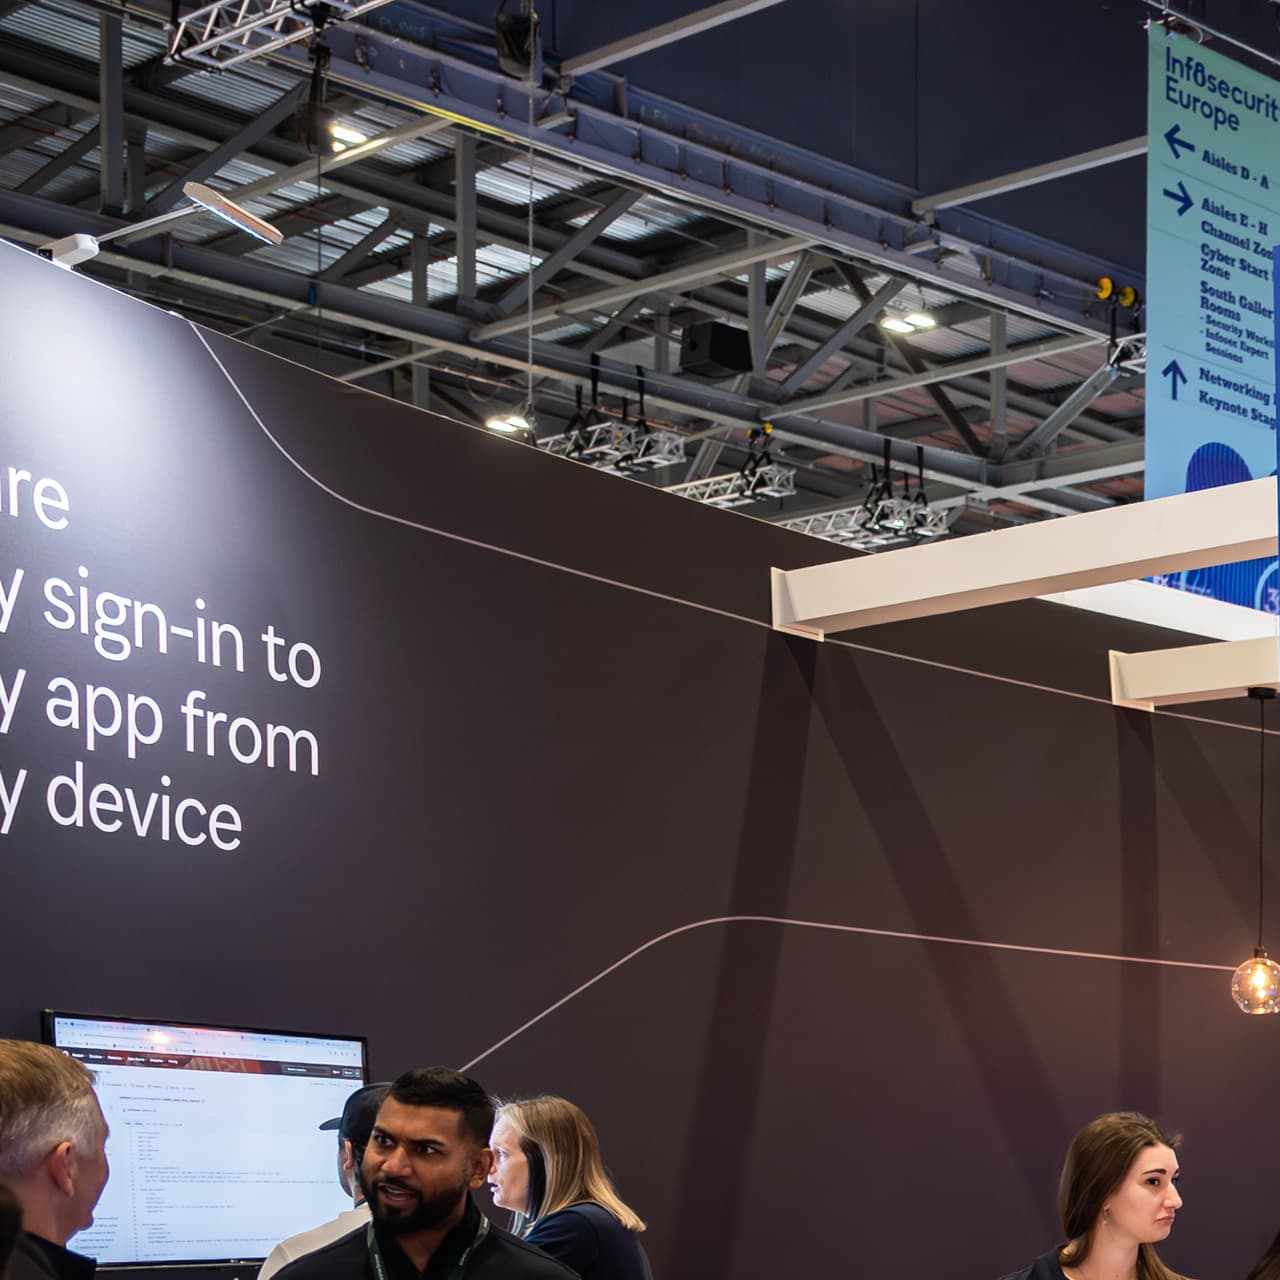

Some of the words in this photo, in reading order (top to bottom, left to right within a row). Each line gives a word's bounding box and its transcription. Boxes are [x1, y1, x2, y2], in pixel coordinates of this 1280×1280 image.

[1166, 75, 1240, 131] Europe
[1202, 150, 1238, 175] Aisles
[1241, 166, 1250, 180] D
[1260, 176, 1270, 189] A
[1201, 198, 1237, 223] Aisles
[1240, 213, 1248, 228] E
[1258, 221, 1268, 236] H
[1201, 221, 1250, 251] Channel
[1201, 243, 1236, 267] Cyber
[1239, 258, 1269, 280] Start
[1201, 258, 1231, 280] Zone
[1200, 280, 1236, 305] South
[1200, 296, 1241, 322] Rooms
[1205, 314, 1243, 338] Security
[1205, 342, 1243, 364] Sessions
[1206, 328, 1238, 349] Infosec
[1240, 340, 1269, 360] Expert
[1199, 367, 1271, 406] Networking
[1199, 390, 1248, 418] Keynote
[43, 566, 245, 661] sign-in
[261, 625, 322, 688] to
[46, 677, 163, 759] app
[180, 690, 320, 775] from
[47, 761, 242, 851] device
